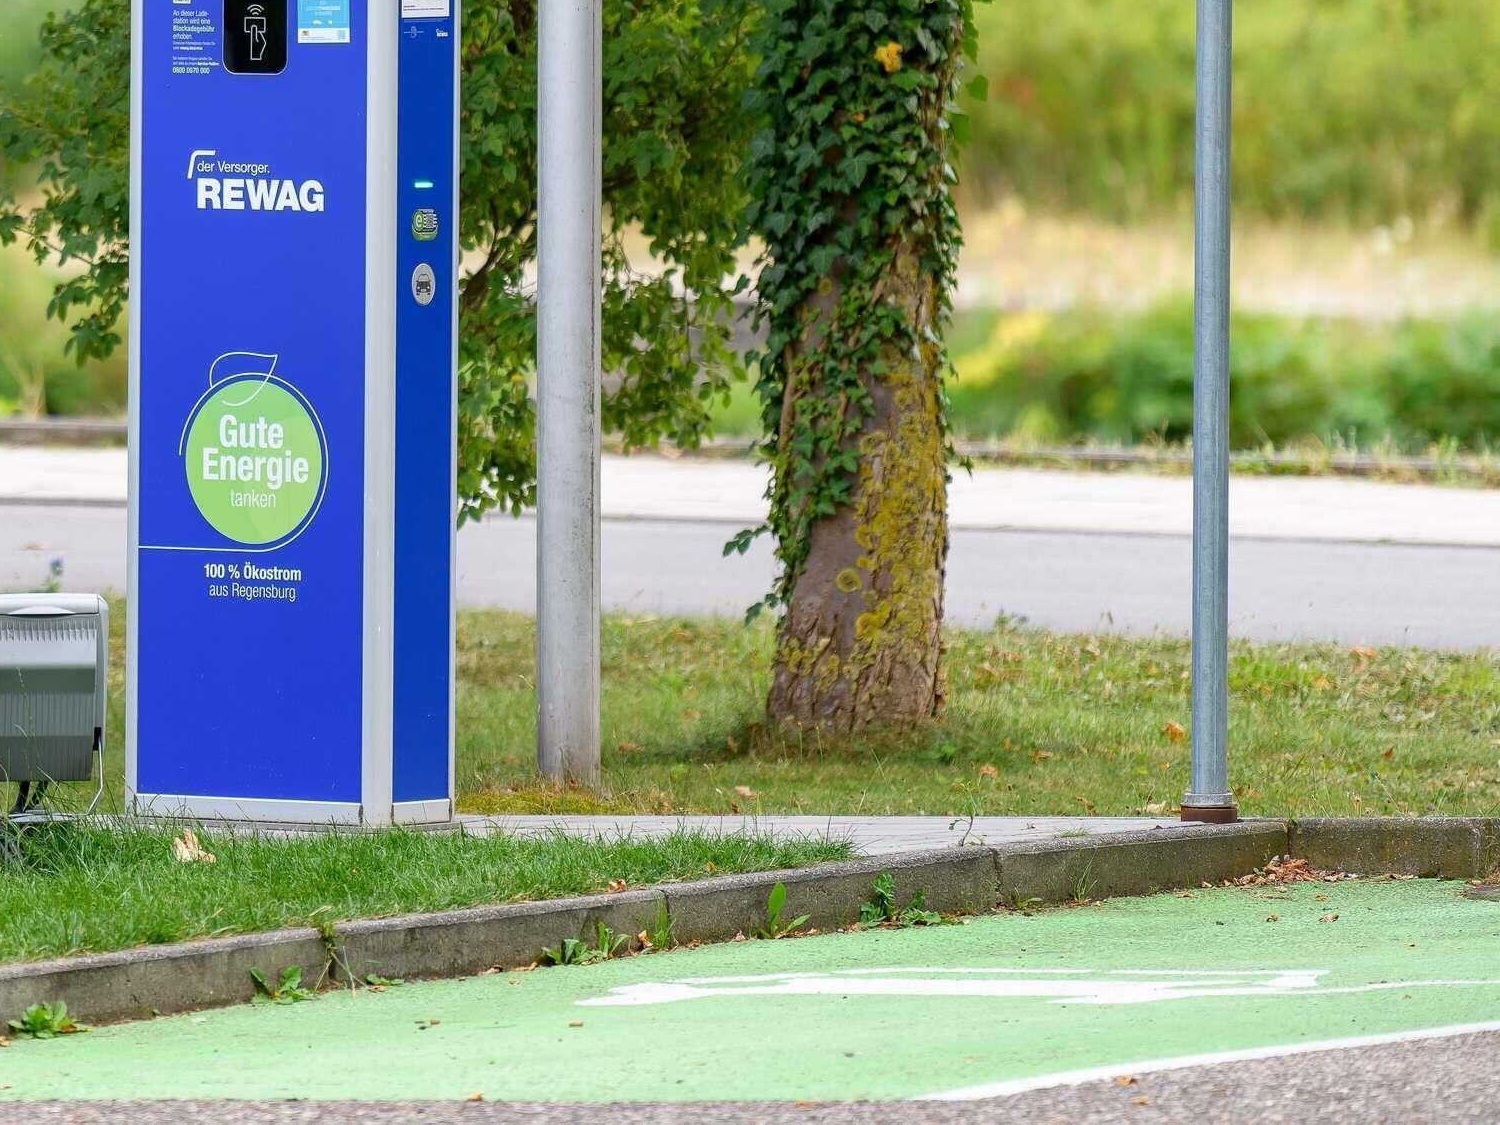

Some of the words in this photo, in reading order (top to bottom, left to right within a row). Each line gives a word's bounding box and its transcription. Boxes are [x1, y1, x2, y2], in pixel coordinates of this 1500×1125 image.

[197, 160, 215, 172] der
[217, 160, 270, 177] Versorger.
[196, 178, 325, 212] REWAG
[219, 414, 284, 449] Gute
[202, 447, 309, 490] Energie
[230, 490, 276, 508] tanken
[204, 563, 225, 579] 100
[228, 564, 240, 579] %
[243, 561, 302, 581] Ökostrom
[209, 584, 228, 597] aus
[232, 582, 296, 602] Regensburg
